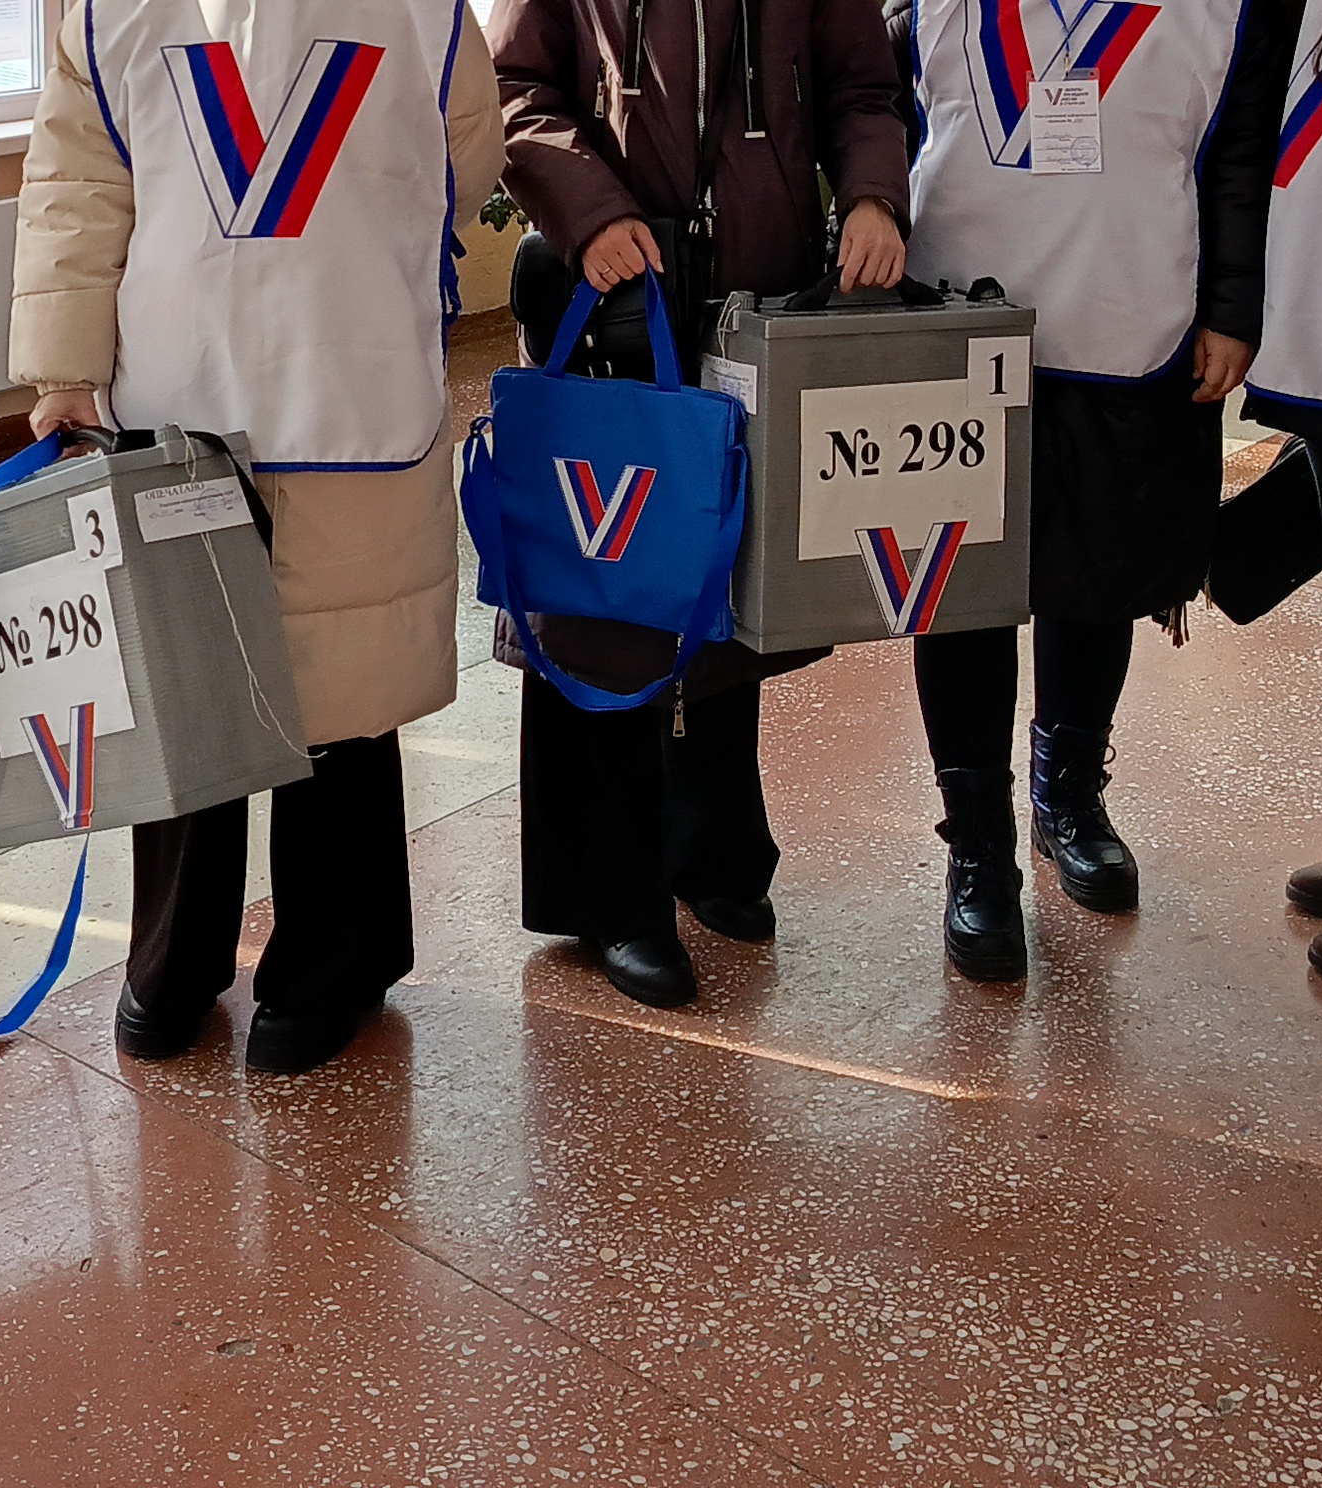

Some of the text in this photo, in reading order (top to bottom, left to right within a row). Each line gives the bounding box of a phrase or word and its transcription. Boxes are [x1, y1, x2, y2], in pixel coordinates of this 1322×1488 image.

[989, 353, 1008, 395] 1
[819, 419, 985, 481] № 298
[145, 482, 205, 501] ОПЕЧАТАНО
[85, 510, 105, 558] 3
[39, 594, 102, 660] 298
